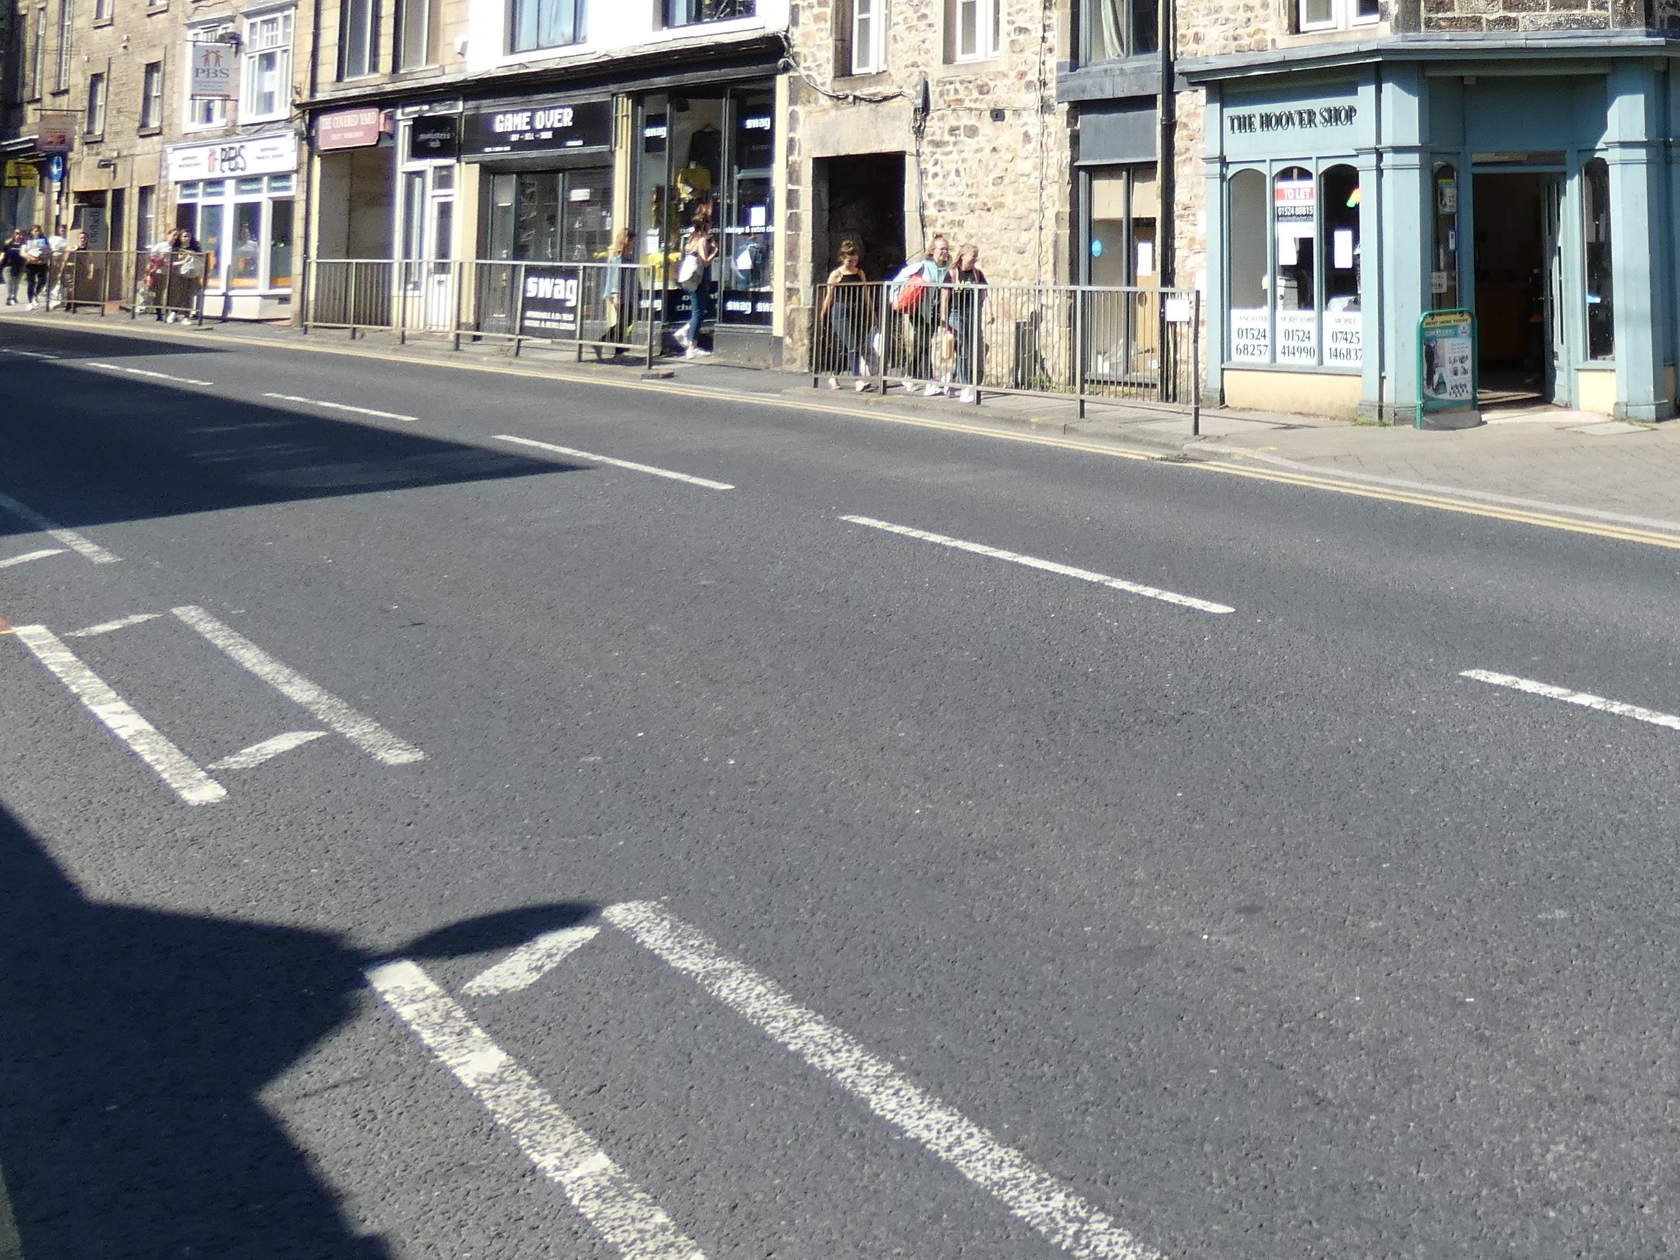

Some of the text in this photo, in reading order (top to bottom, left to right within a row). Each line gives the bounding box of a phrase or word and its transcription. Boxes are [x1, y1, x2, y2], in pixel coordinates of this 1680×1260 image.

[195, 67, 229, 78] PBS
[494, 108, 574, 132] GAME OVER
[745, 117, 771, 130] swag
[1227, 105, 1357, 134] THE HOOVER SHOP
[644, 126, 667, 138] swag
[220, 144, 248, 173] PBS
[1284, 188, 1310, 200] TO LET
[526, 277, 578, 307] swag
[726, 300, 752, 314] swag
[1237, 327, 1267, 340] 01524
[1284, 329, 1311, 342] 01524
[1331, 330, 1360, 344] 07425
[1235, 343, 1269, 356] 68257
[1281, 345, 1316, 359] 414990
